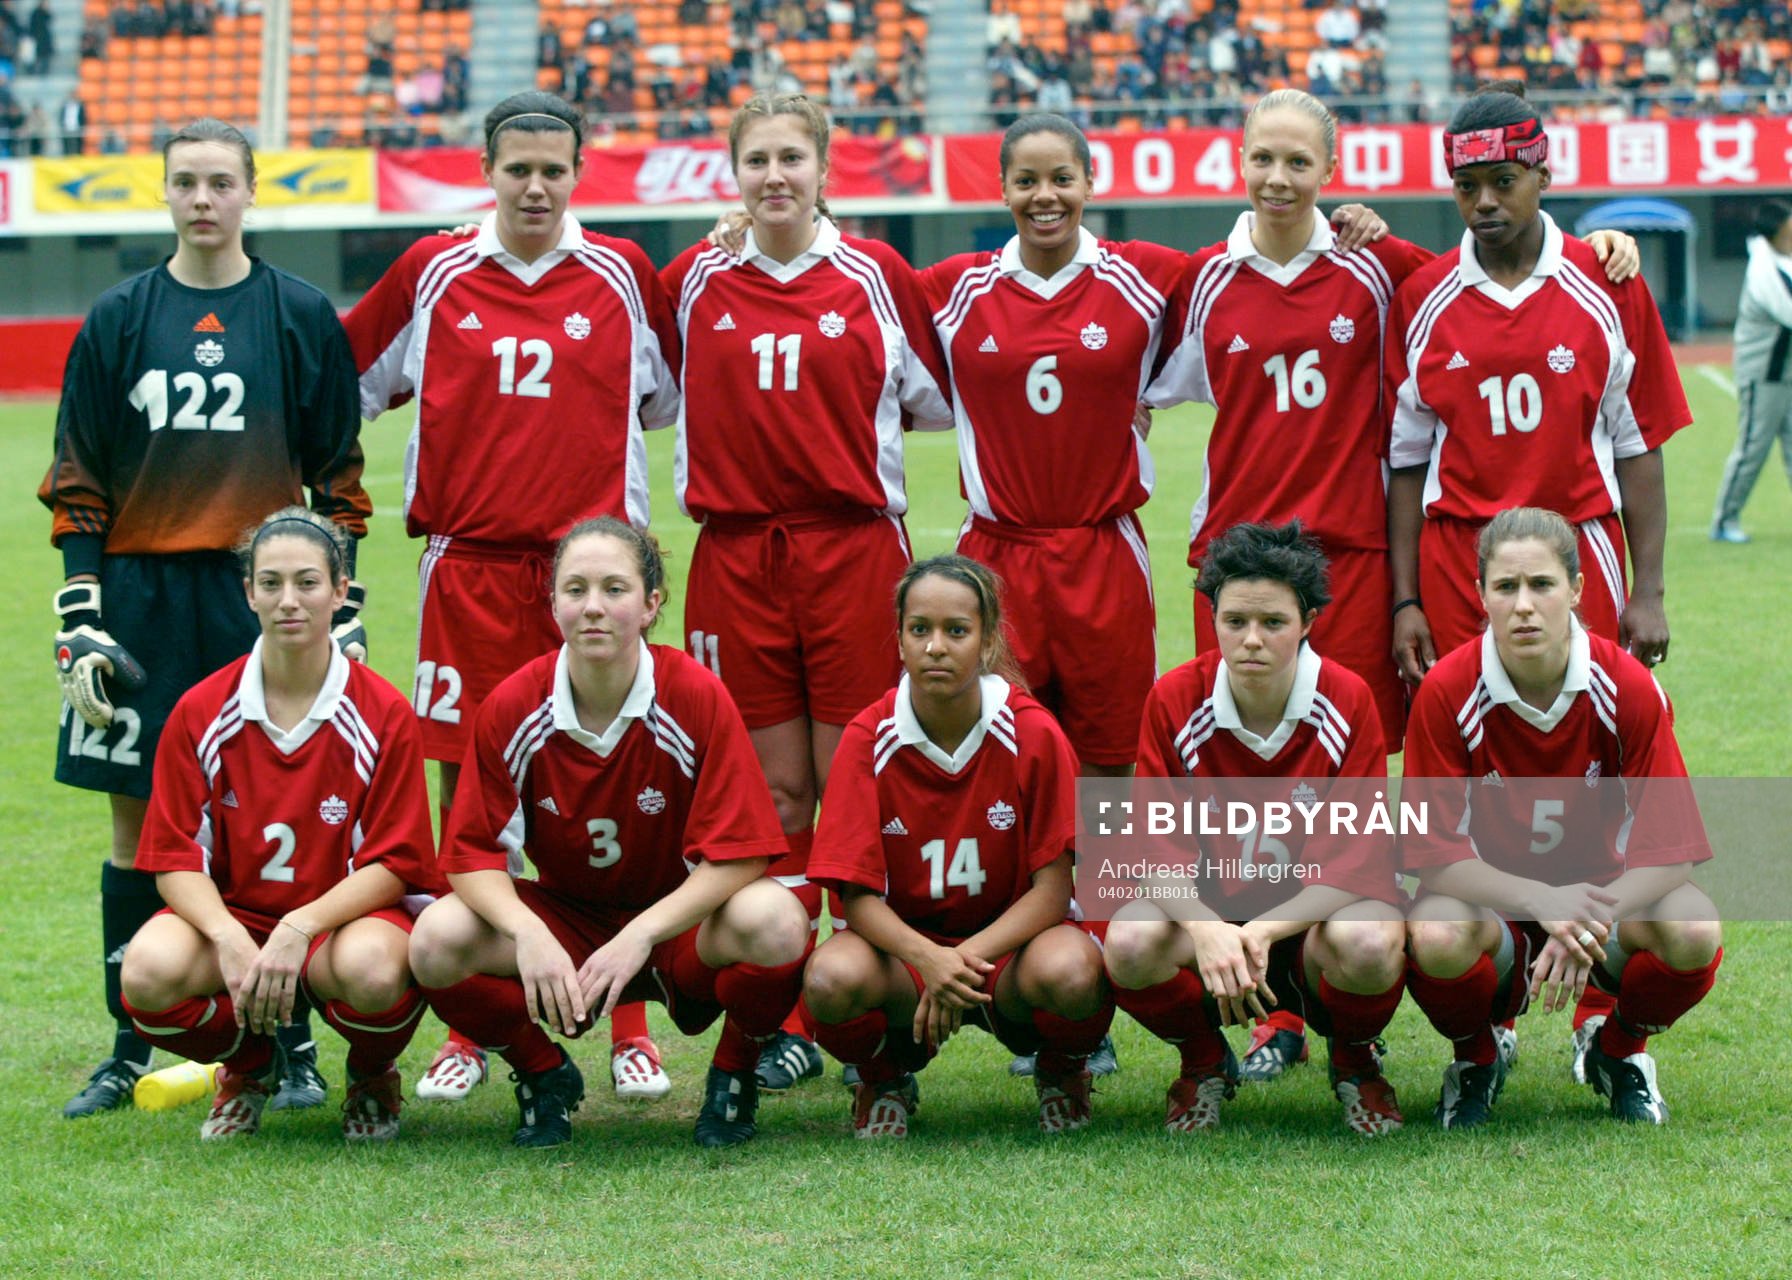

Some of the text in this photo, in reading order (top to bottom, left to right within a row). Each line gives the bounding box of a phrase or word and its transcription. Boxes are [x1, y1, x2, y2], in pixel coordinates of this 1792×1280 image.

[492, 336, 554, 398] 12
[751, 333, 801, 391] 11
[1026, 355, 1063, 414] 6
[1263, 349, 1327, 412] 16
[128, 369, 245, 431] 122
[1478, 373, 1543, 436] 10
[690, 630, 721, 678] 11
[416, 660, 462, 724] 12
[260, 822, 296, 883] 2
[586, 818, 622, 868] 3
[1529, 800, 1565, 855] 5
[920, 838, 987, 899] 14
